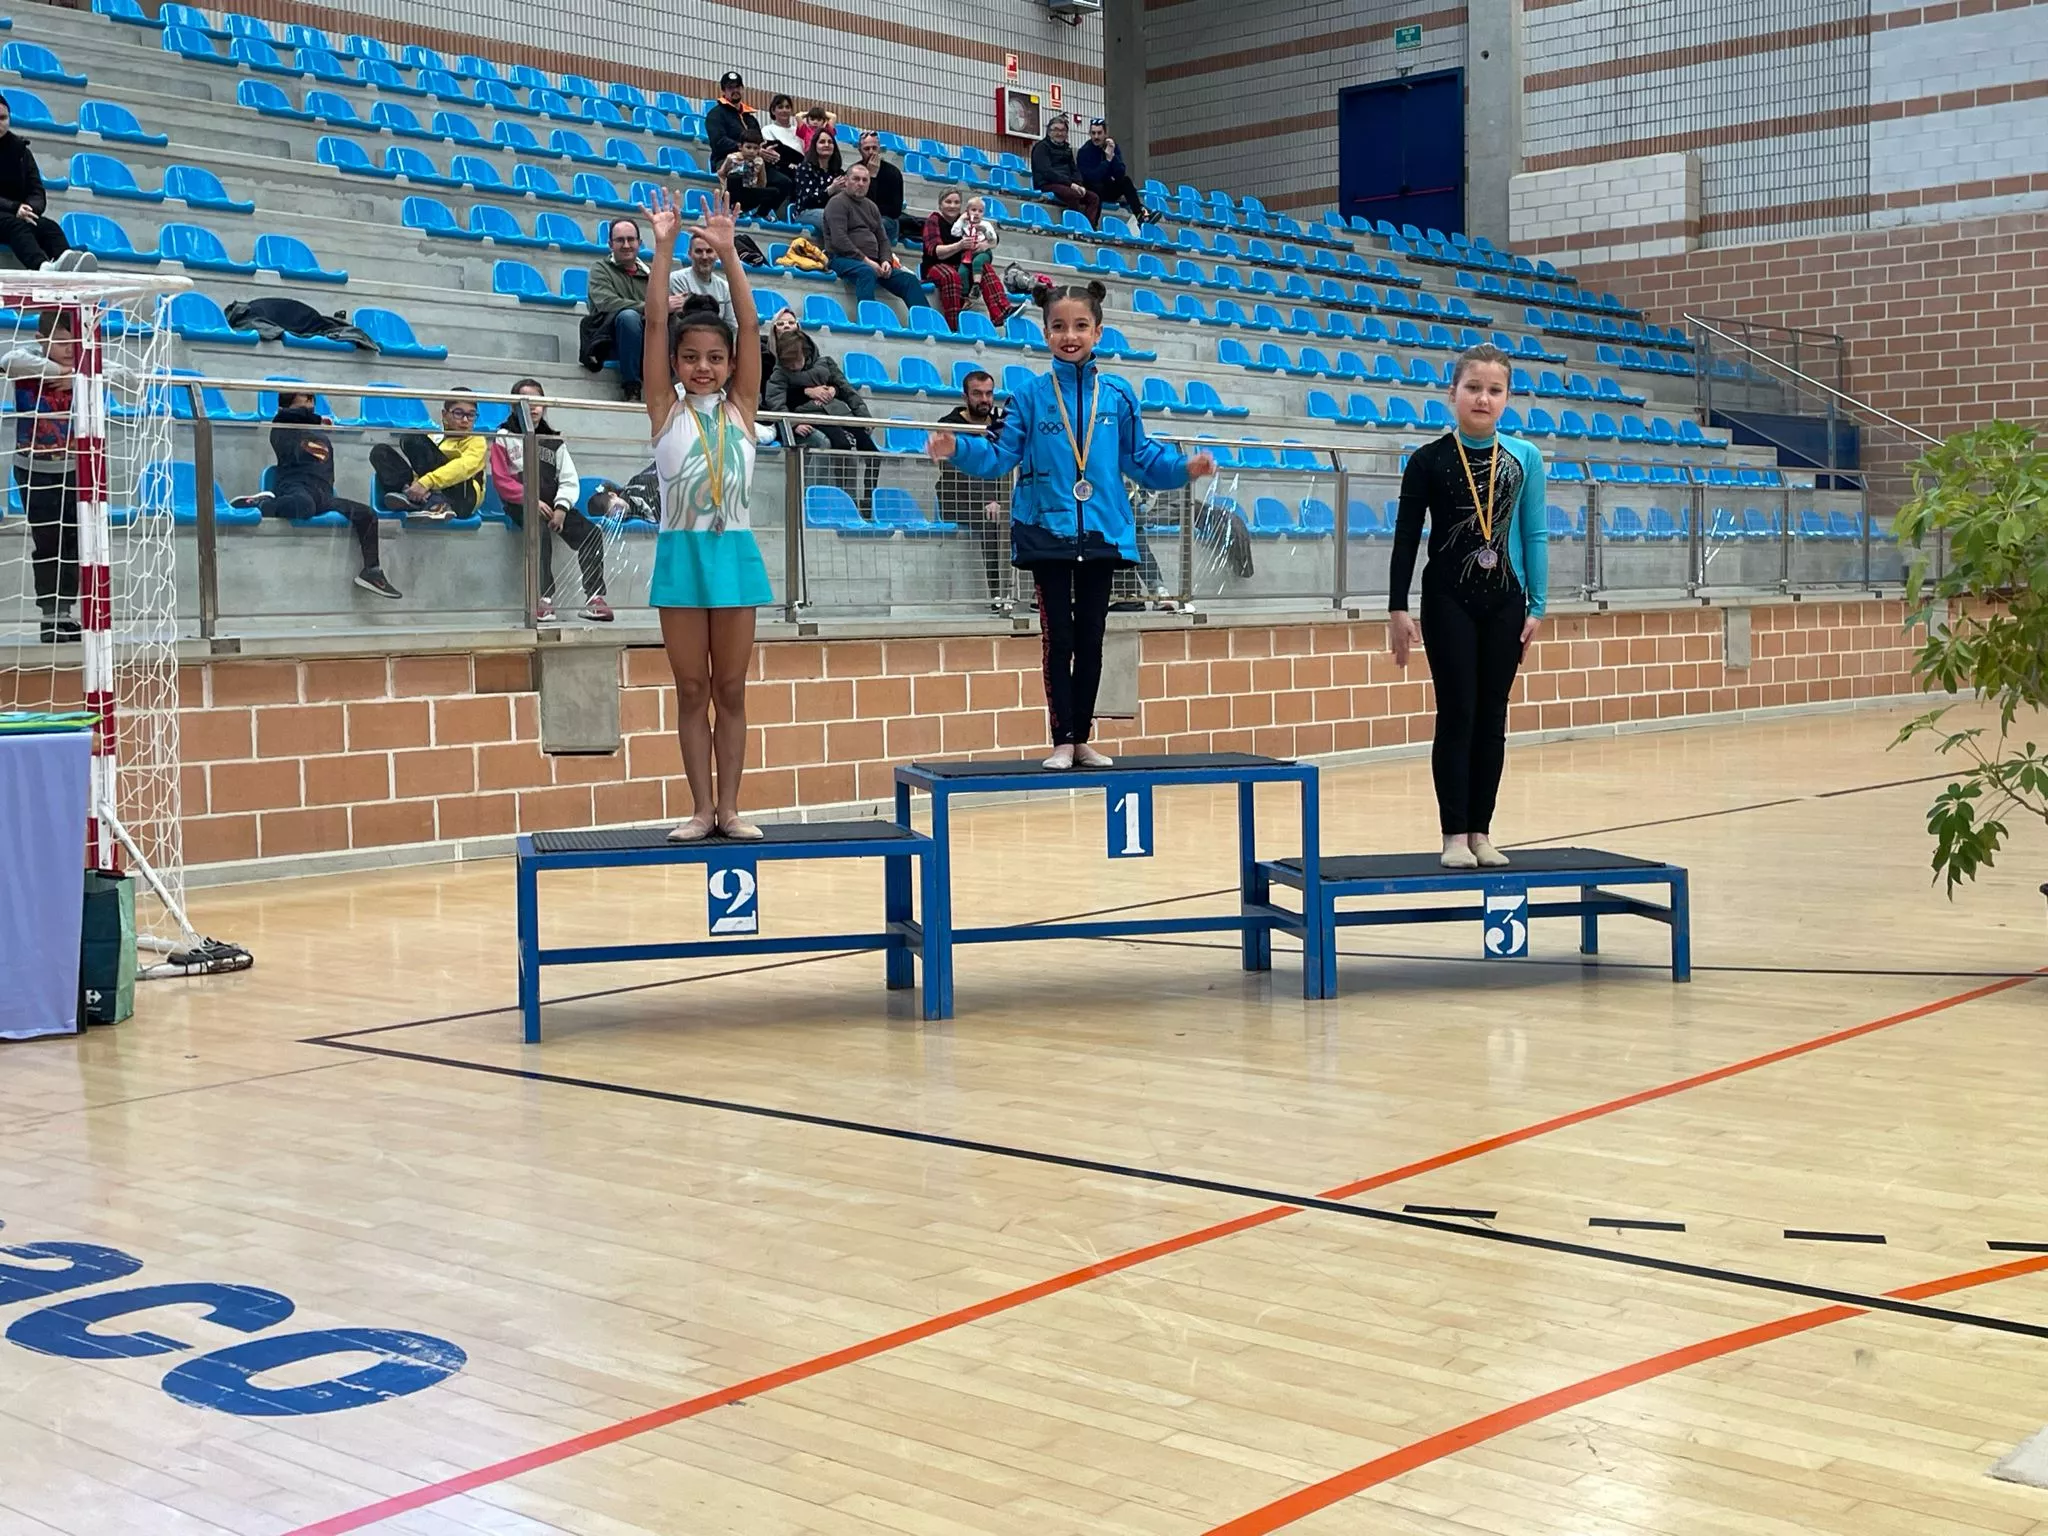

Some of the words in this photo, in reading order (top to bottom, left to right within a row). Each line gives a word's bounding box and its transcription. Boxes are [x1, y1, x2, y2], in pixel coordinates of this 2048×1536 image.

[1114, 792, 1146, 854] 1
[709, 868, 757, 933] 2
[1485, 894, 1526, 955] 3
